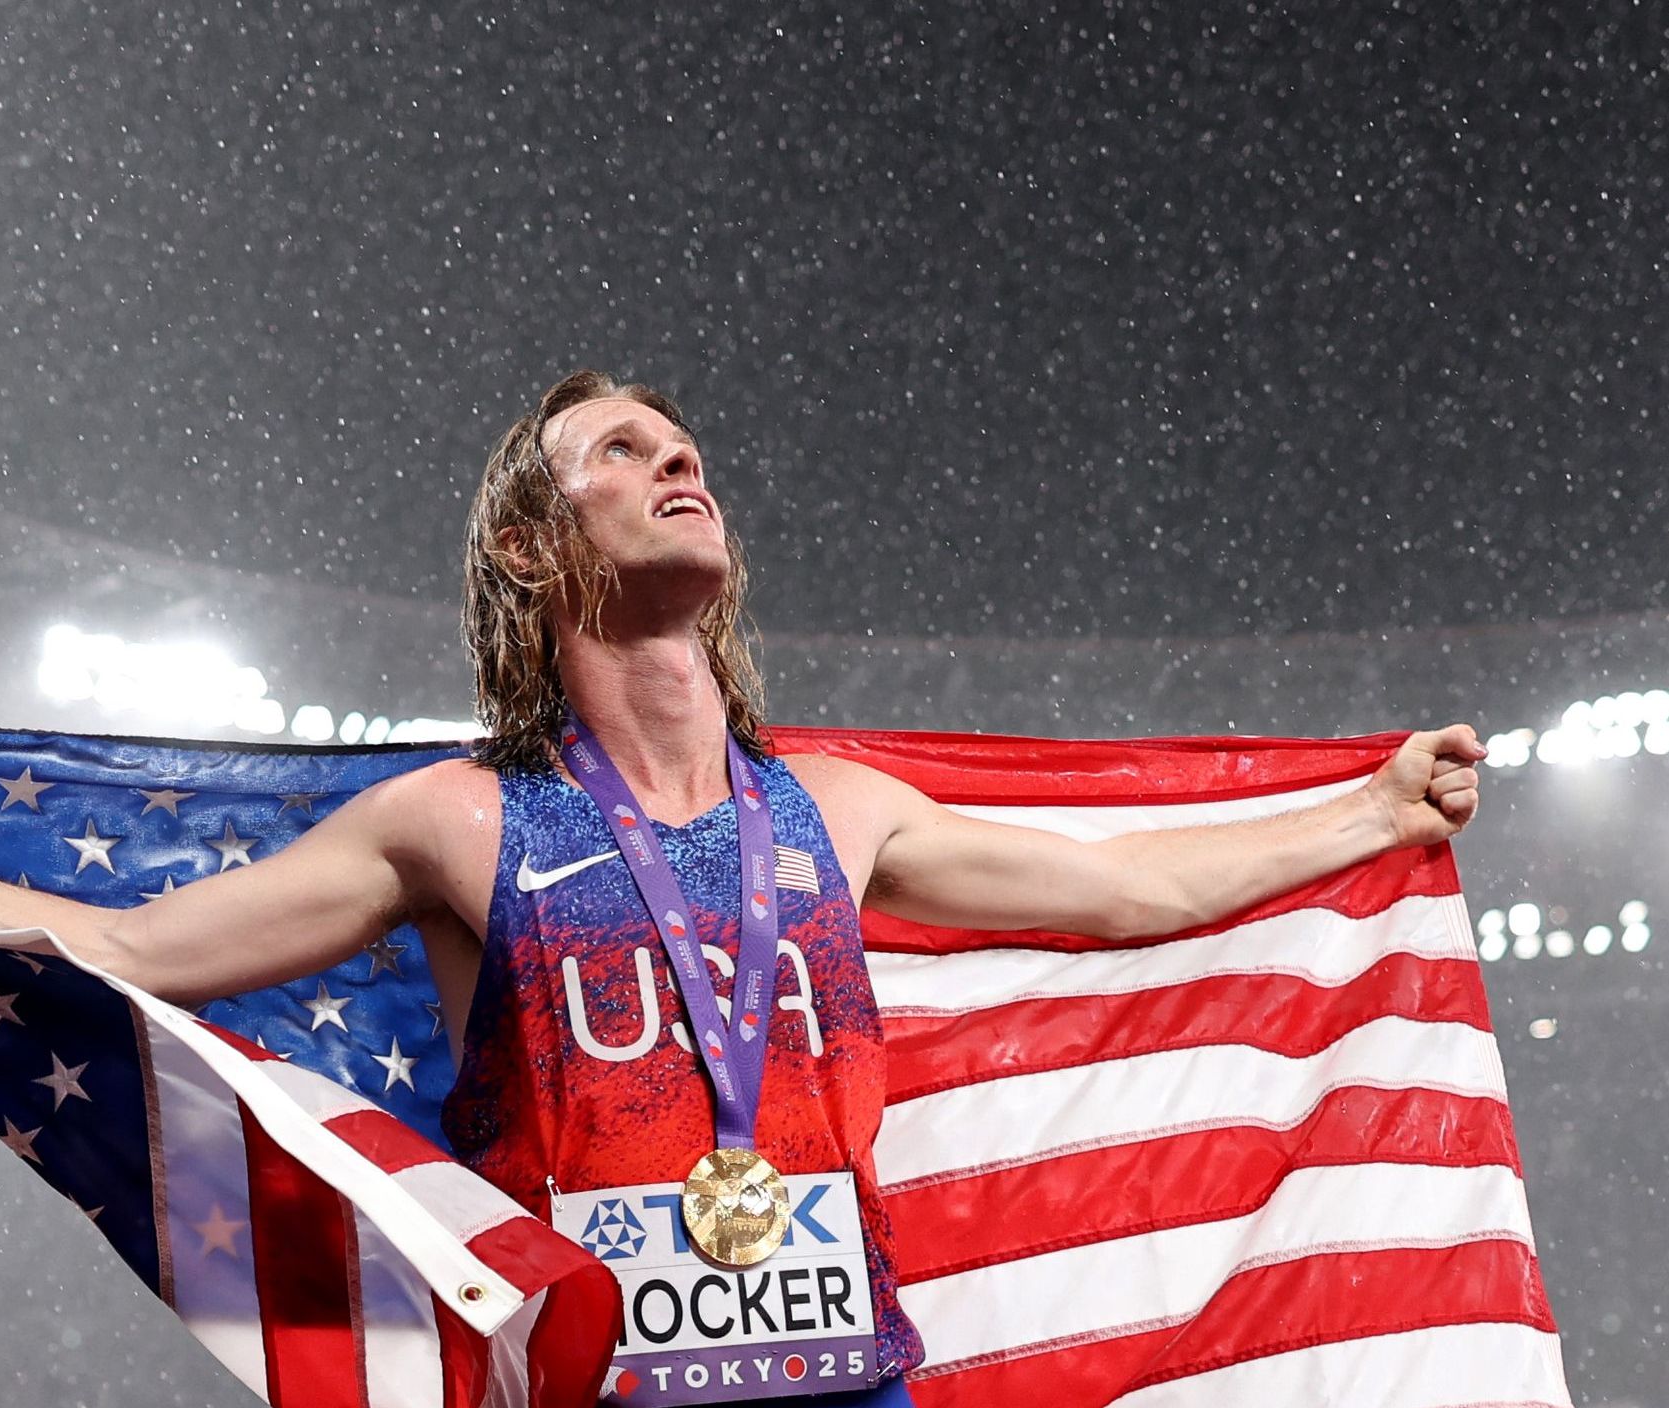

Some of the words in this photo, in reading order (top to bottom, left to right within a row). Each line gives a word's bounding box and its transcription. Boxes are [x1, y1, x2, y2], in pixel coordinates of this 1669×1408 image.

[643, 1184, 841, 1254] TK
[617, 1266, 856, 1347] OCKER
[651, 1354, 808, 1392] TOKYO
[818, 1351, 865, 1377] 25
